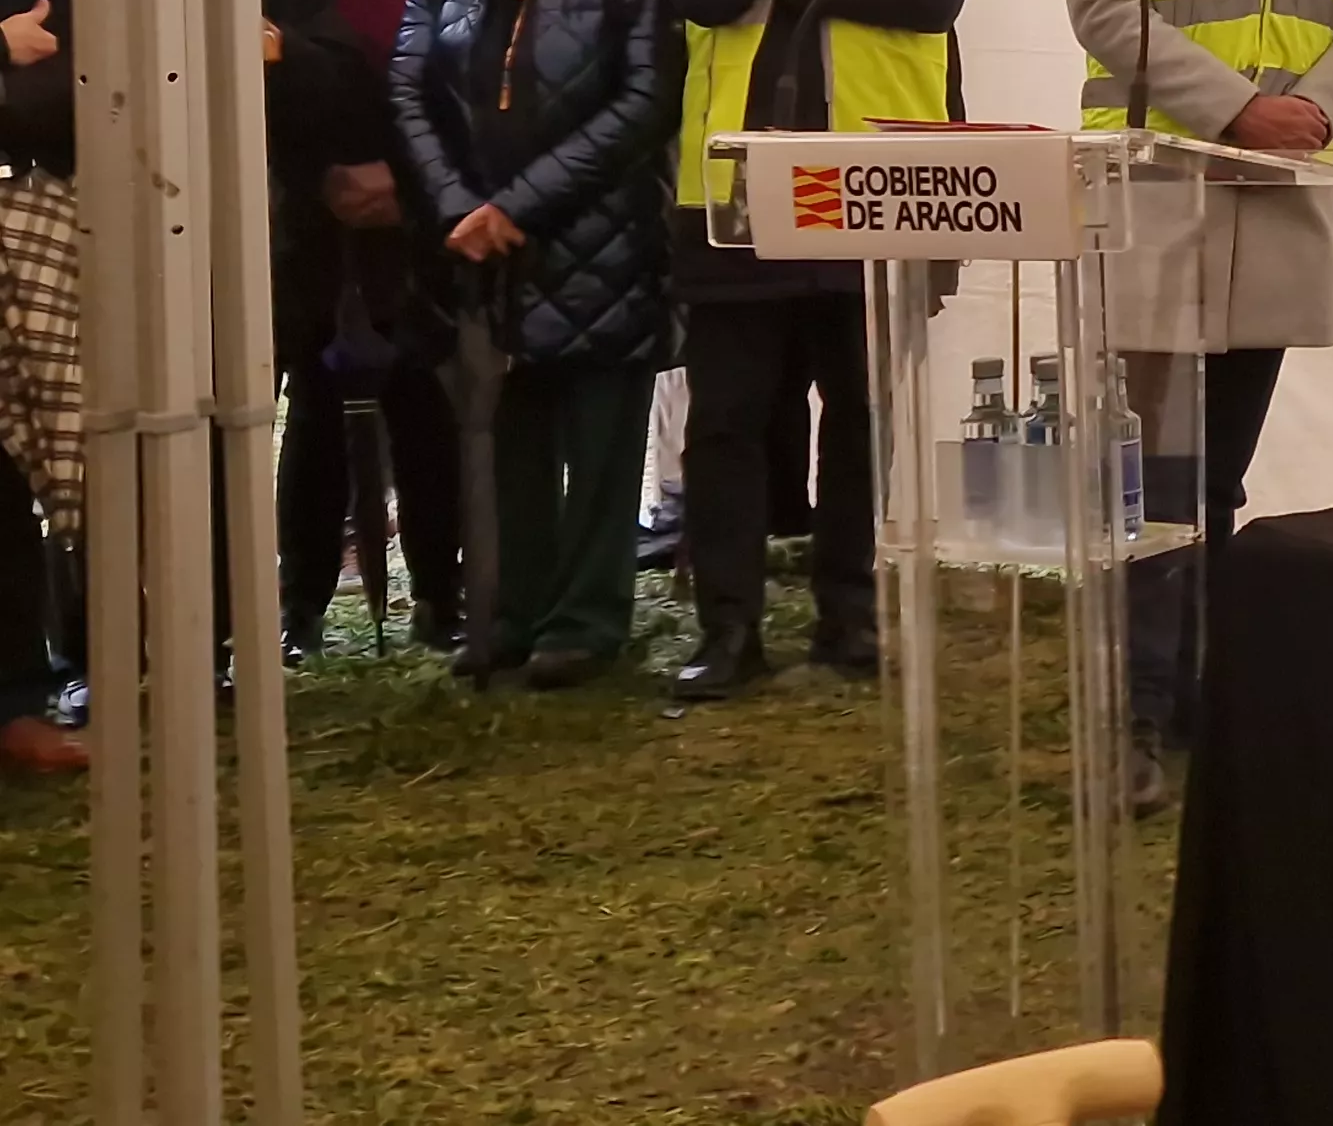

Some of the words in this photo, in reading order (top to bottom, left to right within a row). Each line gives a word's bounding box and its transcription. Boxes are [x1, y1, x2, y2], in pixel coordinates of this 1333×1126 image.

[845, 166, 997, 198] GOBIERNO
[846, 200, 884, 230] DE
[895, 201, 1023, 232] ARAGON
